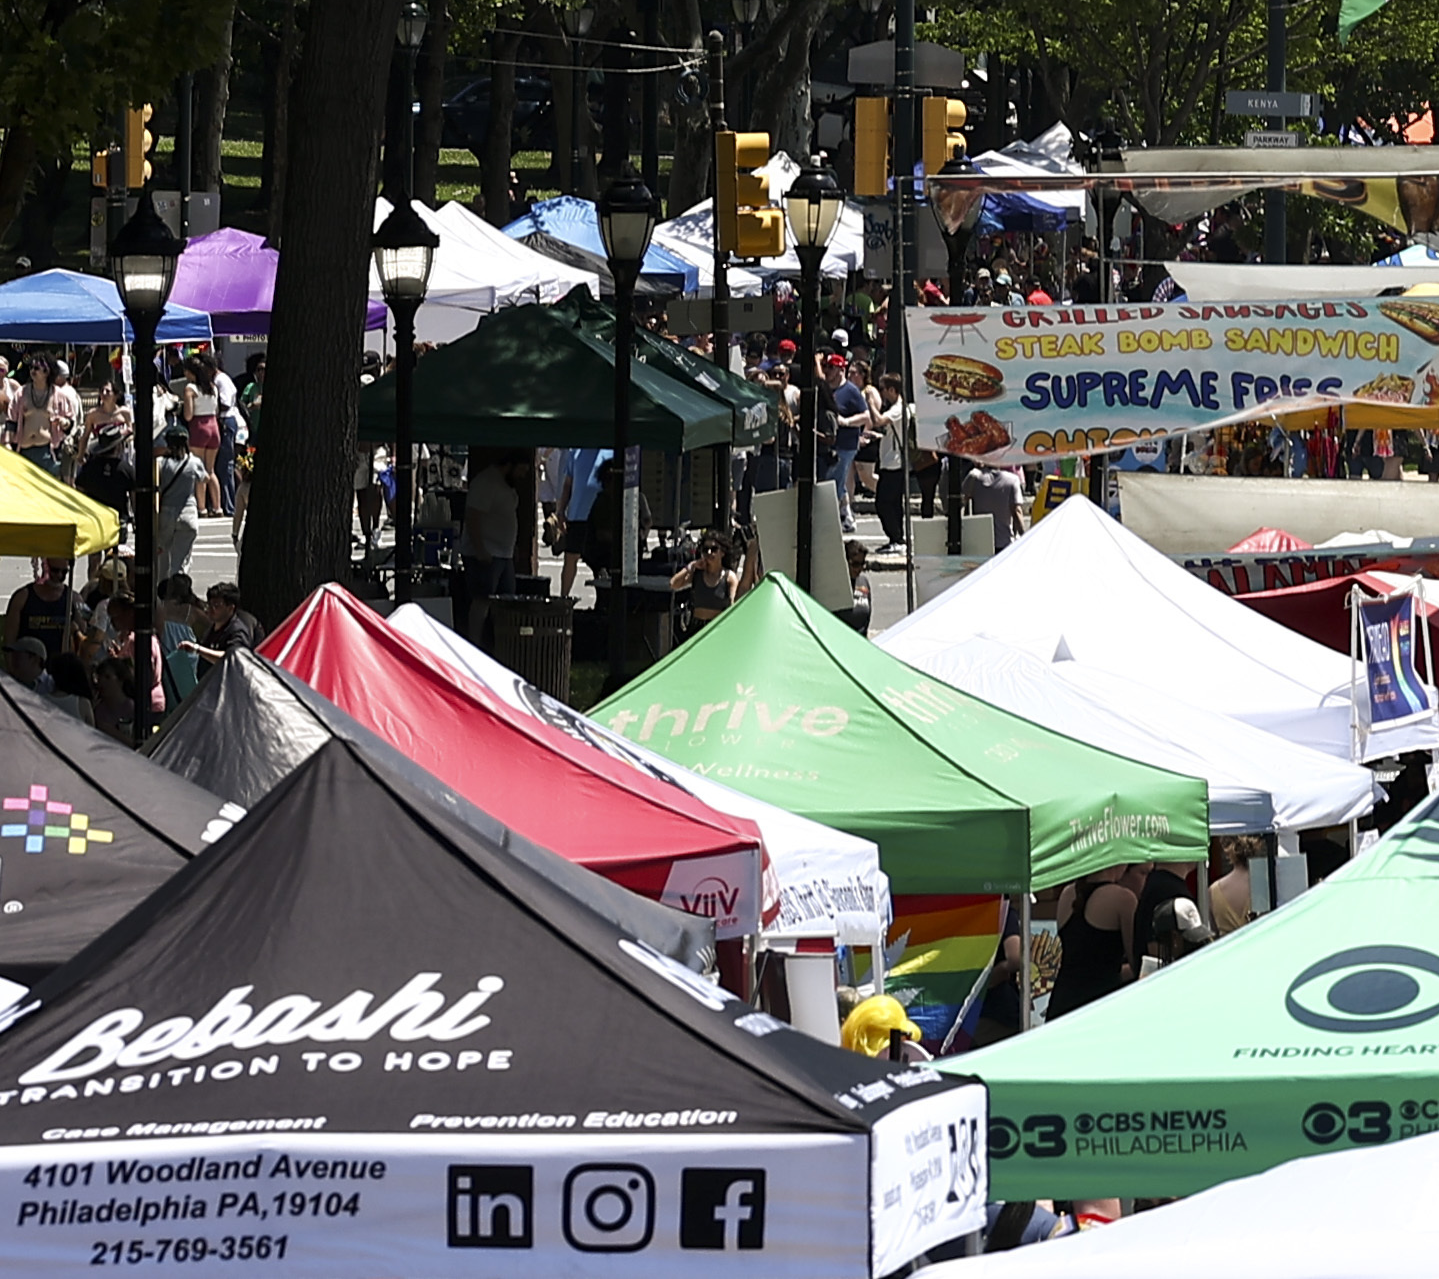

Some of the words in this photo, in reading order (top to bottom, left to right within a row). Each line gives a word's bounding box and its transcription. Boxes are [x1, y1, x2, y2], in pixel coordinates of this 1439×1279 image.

[1247, 98, 1279, 109] KENYA
[1252, 135, 1290, 145] PARKWAY
[994, 330, 1106, 361] STEAK
[1117, 327, 1213, 354] BOMB
[1225, 326, 1400, 364] SANDWICH
[1020, 367, 1220, 412] SUPREME
[608, 683, 850, 743] thrive
[683, 762, 821, 783] Wellness
[1068, 806, 1171, 854] ThriveFlower.com
[680, 886, 741, 921] ViiV
[17, 971, 505, 1085] Bebashi
[1232, 1046, 1357, 1060] FINDING
[0, 1054, 280, 1106] TRANSITION
[301, 1051, 363, 1073] TO
[383, 1048, 514, 1072] HOPE
[42, 1125, 120, 1142] Case
[126, 1115, 328, 1138] Management
[408, 1111, 577, 1130] Prevention
[582, 1106, 740, 1129] Education
[1022, 1113, 1067, 1158] 3
[1095, 1112, 1140, 1133] CBS
[1143, 1108, 1228, 1132] NEWS
[1346, 1100, 1393, 1143] 3
[1074, 1132, 1249, 1157] PHILADELPHIA
[22, 1162, 96, 1189] 4101
[105, 1153, 263, 1187] Woodland
[267, 1156, 388, 1183] Avenue
[16, 1193, 207, 1228] Philadelphia
[216, 1190, 362, 1222] PA,19104
[89, 1234, 291, 1267] 215-769-3561
